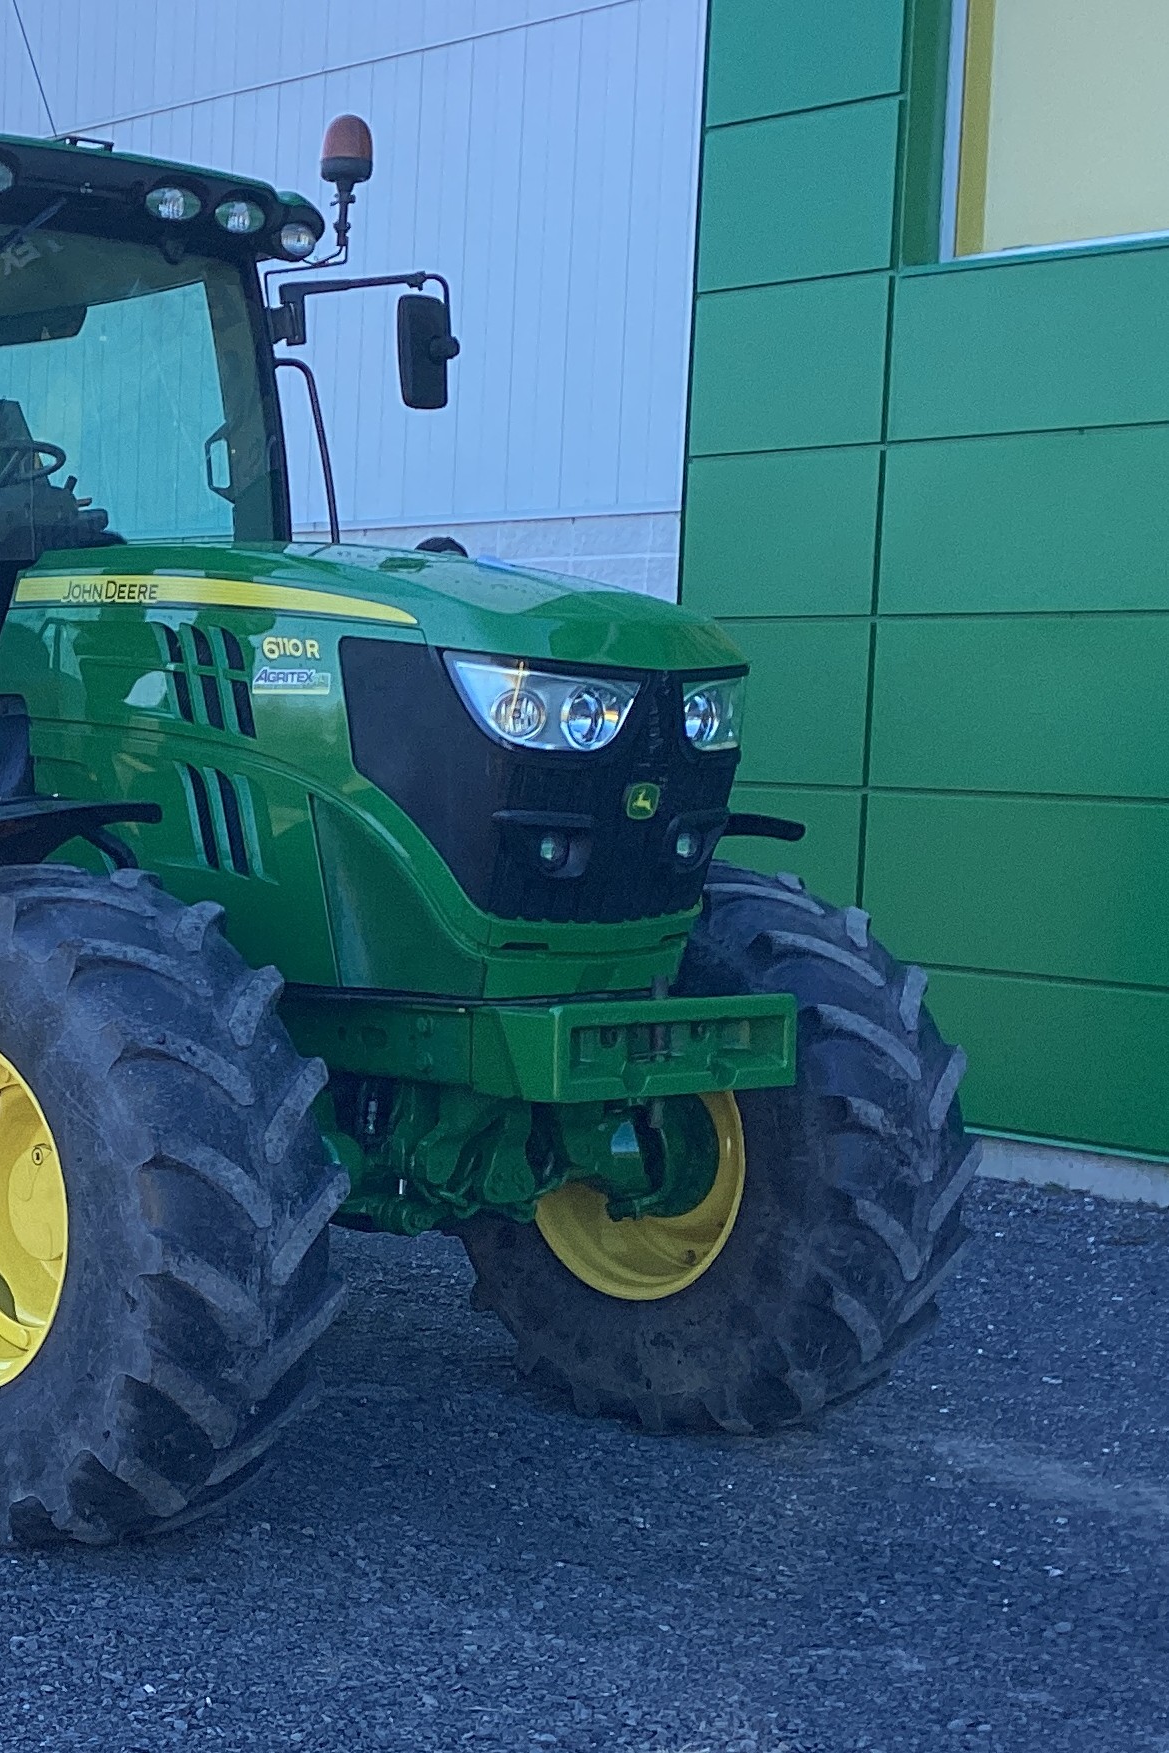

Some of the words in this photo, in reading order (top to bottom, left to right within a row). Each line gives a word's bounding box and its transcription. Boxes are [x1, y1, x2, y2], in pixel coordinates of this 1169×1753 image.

[62, 580, 103, 600] JOHN
[105, 580, 159, 600] DEERE
[255, 668, 314, 684] AGRITEX
